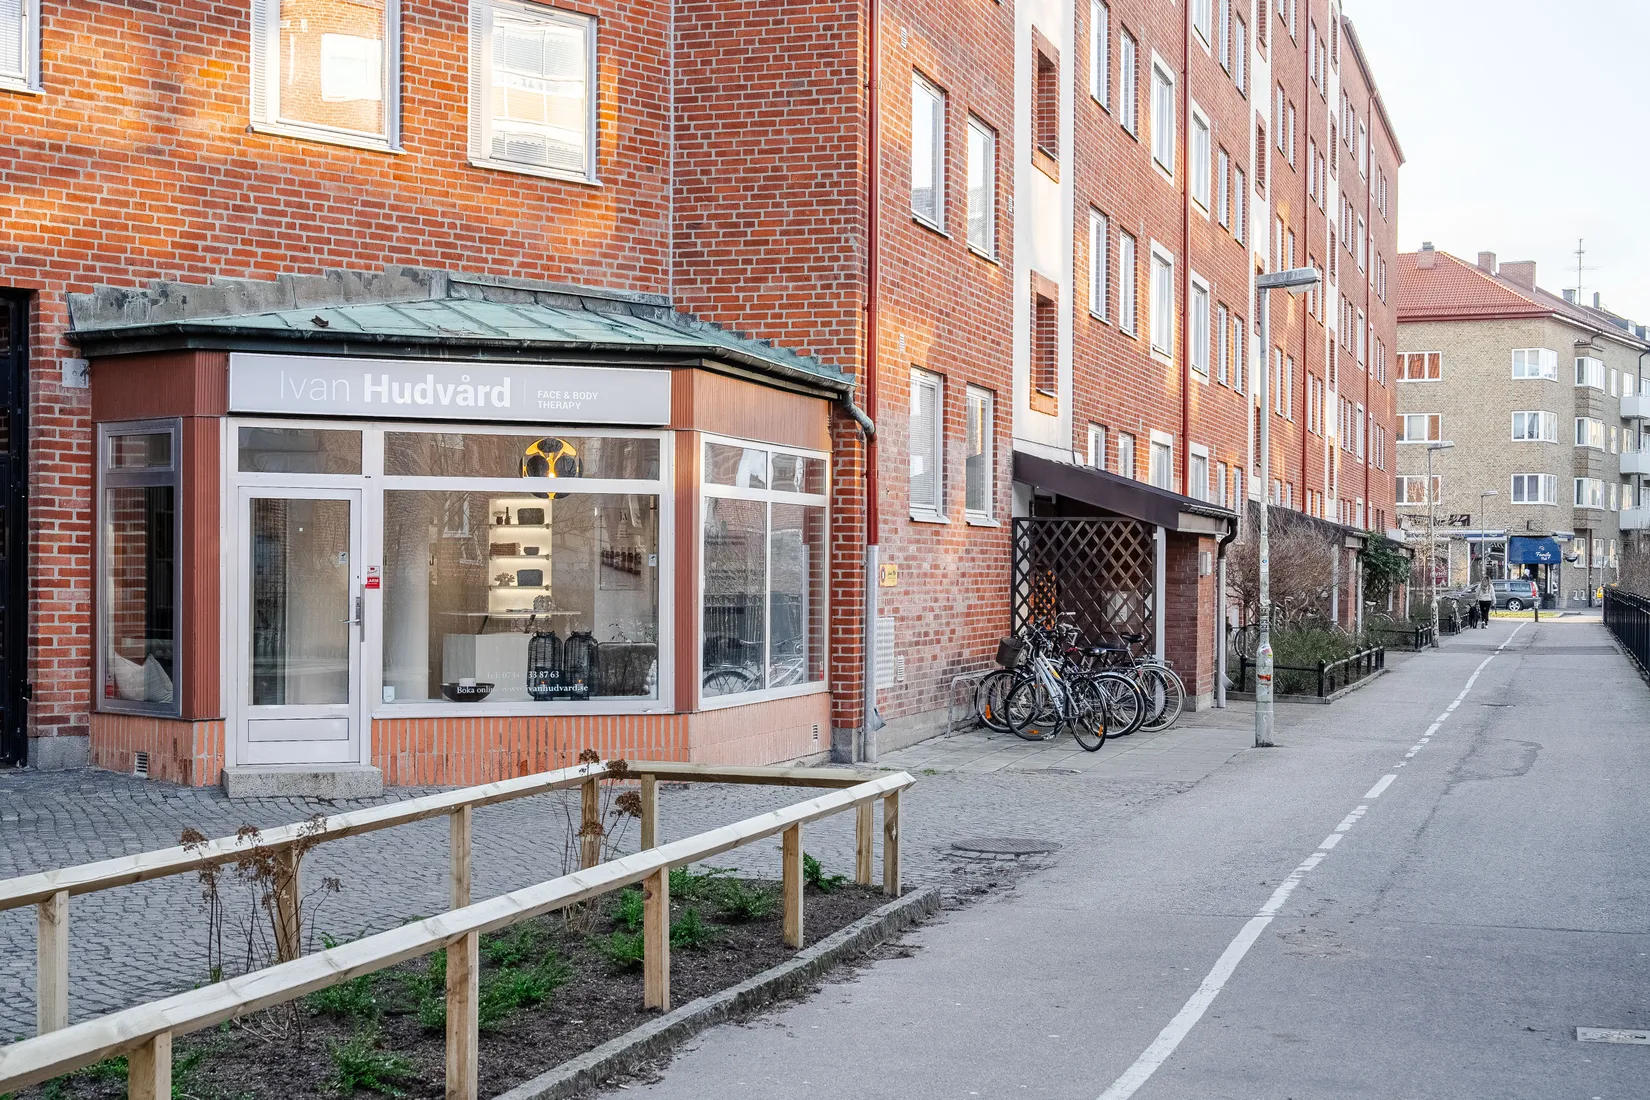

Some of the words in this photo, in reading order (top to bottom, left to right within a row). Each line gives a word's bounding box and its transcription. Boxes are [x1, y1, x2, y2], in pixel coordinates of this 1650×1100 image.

[280, 369, 350, 402] Ivan
[364, 373, 511, 408] Hudvård
[537, 390, 562, 399] FACE
[563, 391, 571, 400] &
[572, 391, 599, 400] BODY
[537, 400, 582, 410] THERAPY
[502, 671, 521, 680] 0734
[528, 670, 538, 679] 33
[539, 671, 549, 679] 87
[550, 670, 560, 679] 63
[456, 686, 475, 694] Boka
